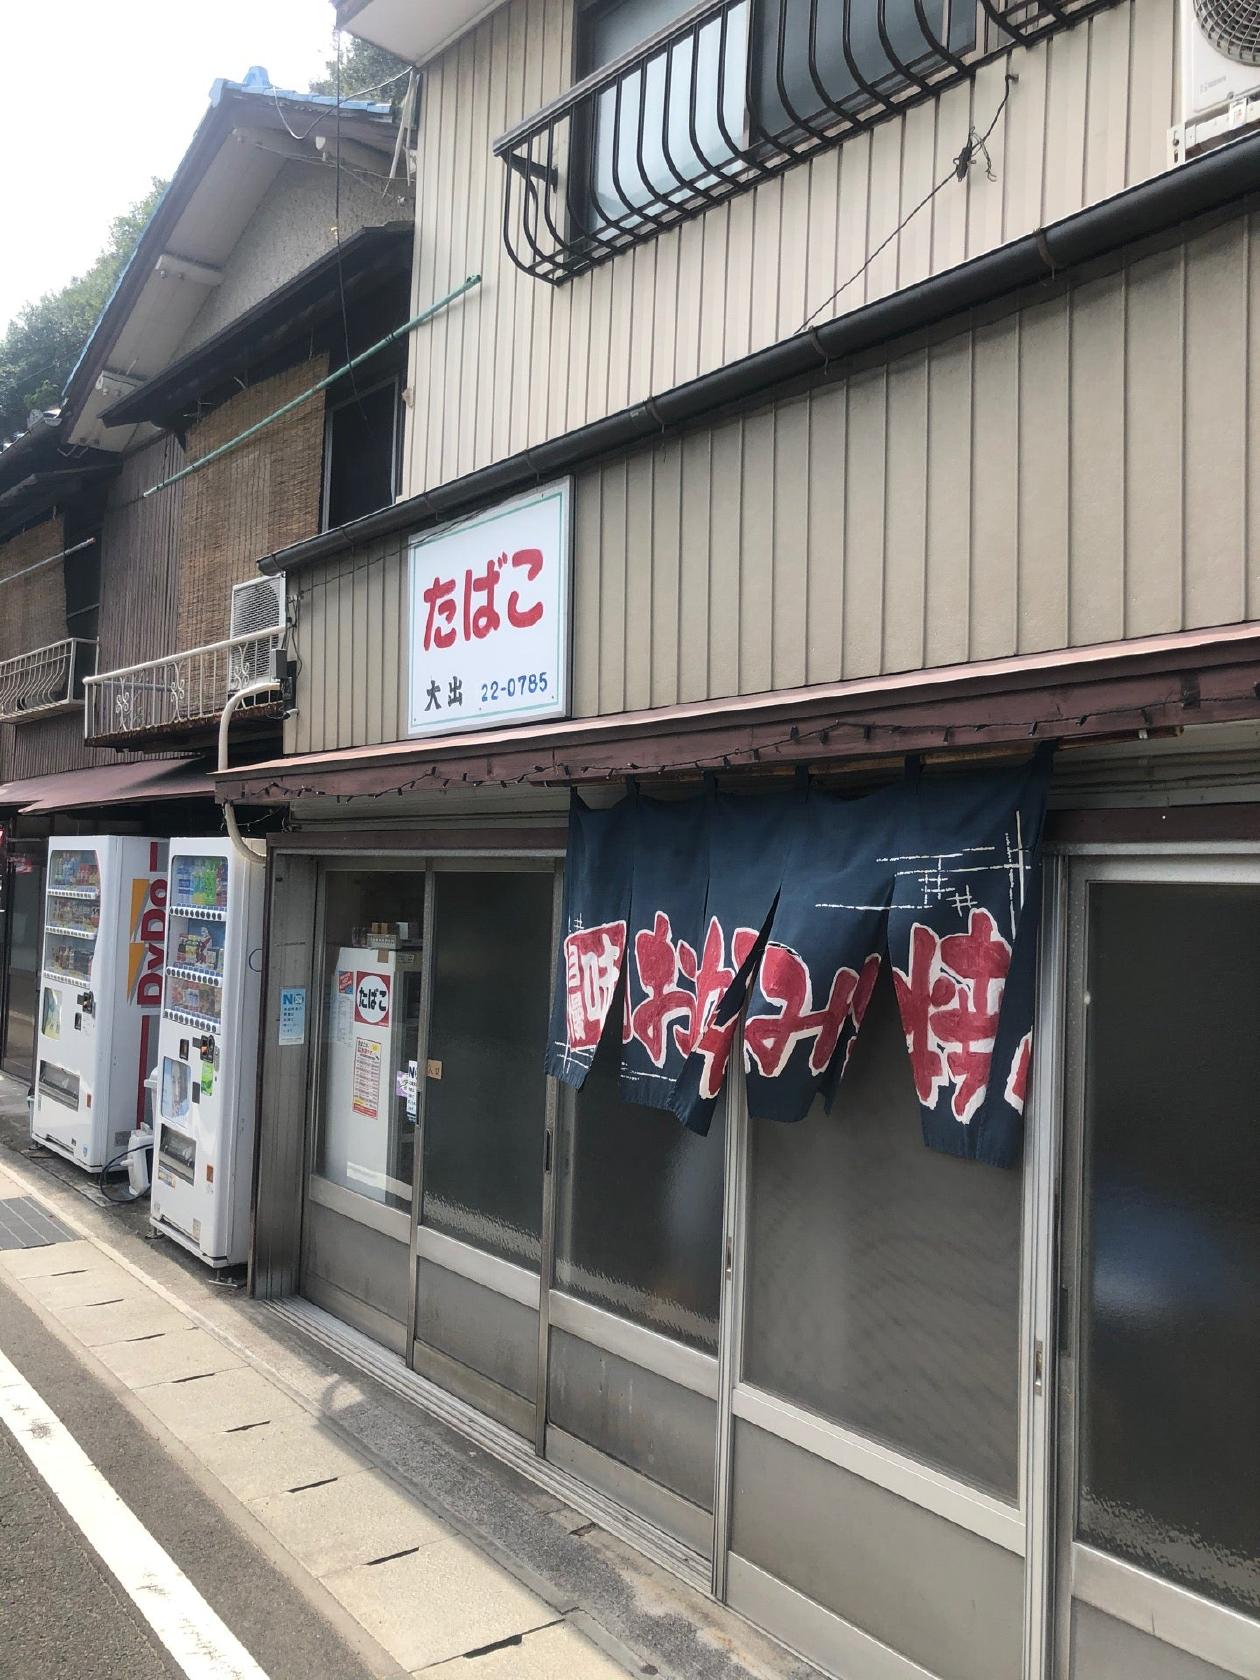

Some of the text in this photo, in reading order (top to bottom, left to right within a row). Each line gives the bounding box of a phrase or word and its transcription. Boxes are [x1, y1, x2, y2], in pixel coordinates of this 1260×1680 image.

[423, 548, 545, 652] たばこ
[424, 671, 548, 712] 大出 22-0785
[358, 986, 387, 1012] たばこ
